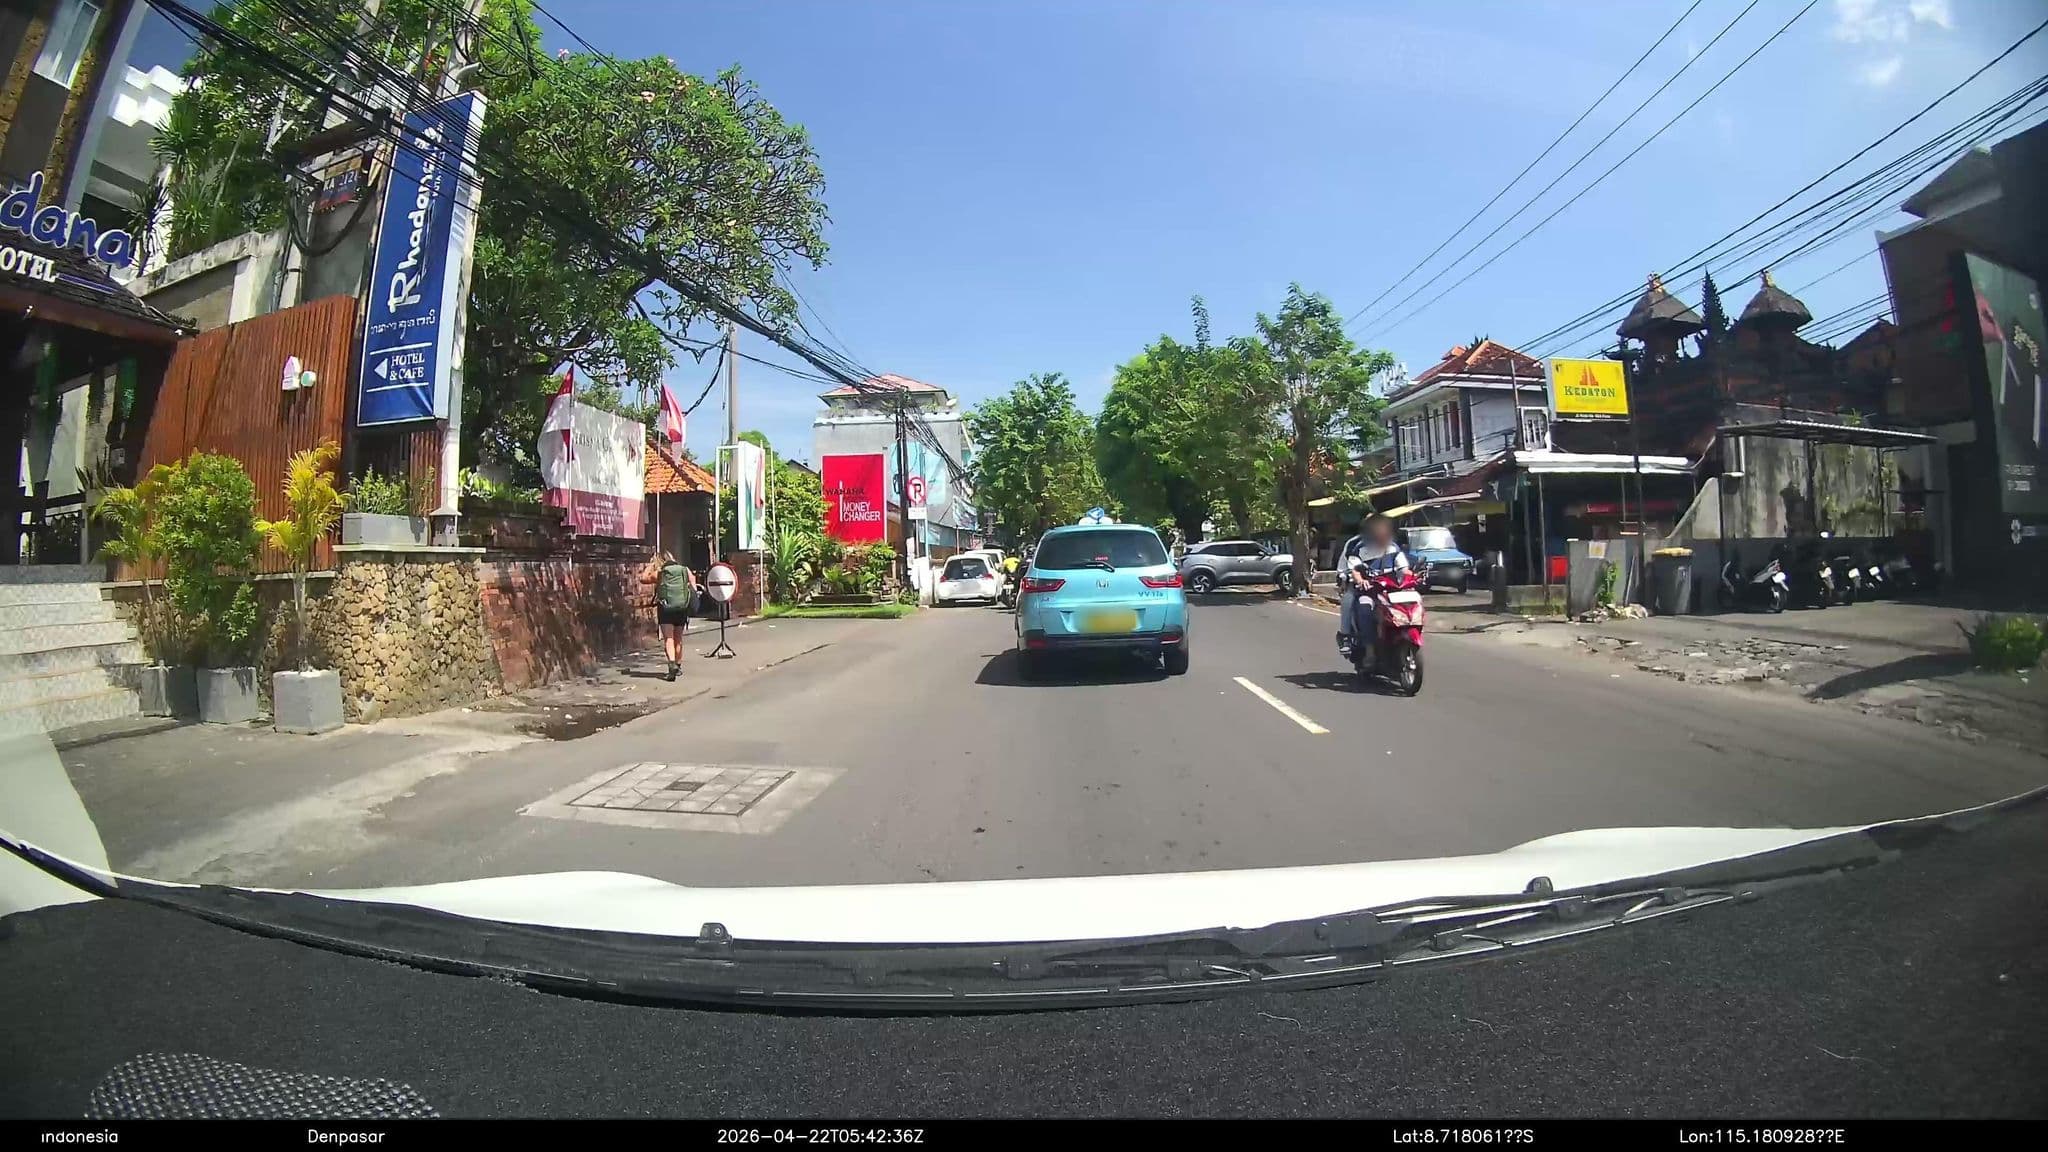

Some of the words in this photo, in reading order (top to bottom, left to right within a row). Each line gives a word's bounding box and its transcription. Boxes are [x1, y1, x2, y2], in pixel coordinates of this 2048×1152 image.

[391, 352, 425, 367] HOTEL
[389, 370, 398, 381] &
[398, 366, 425, 380] CAFE
[843, 501, 871, 511] MONEY
[843, 510, 881, 522] CHANGER
